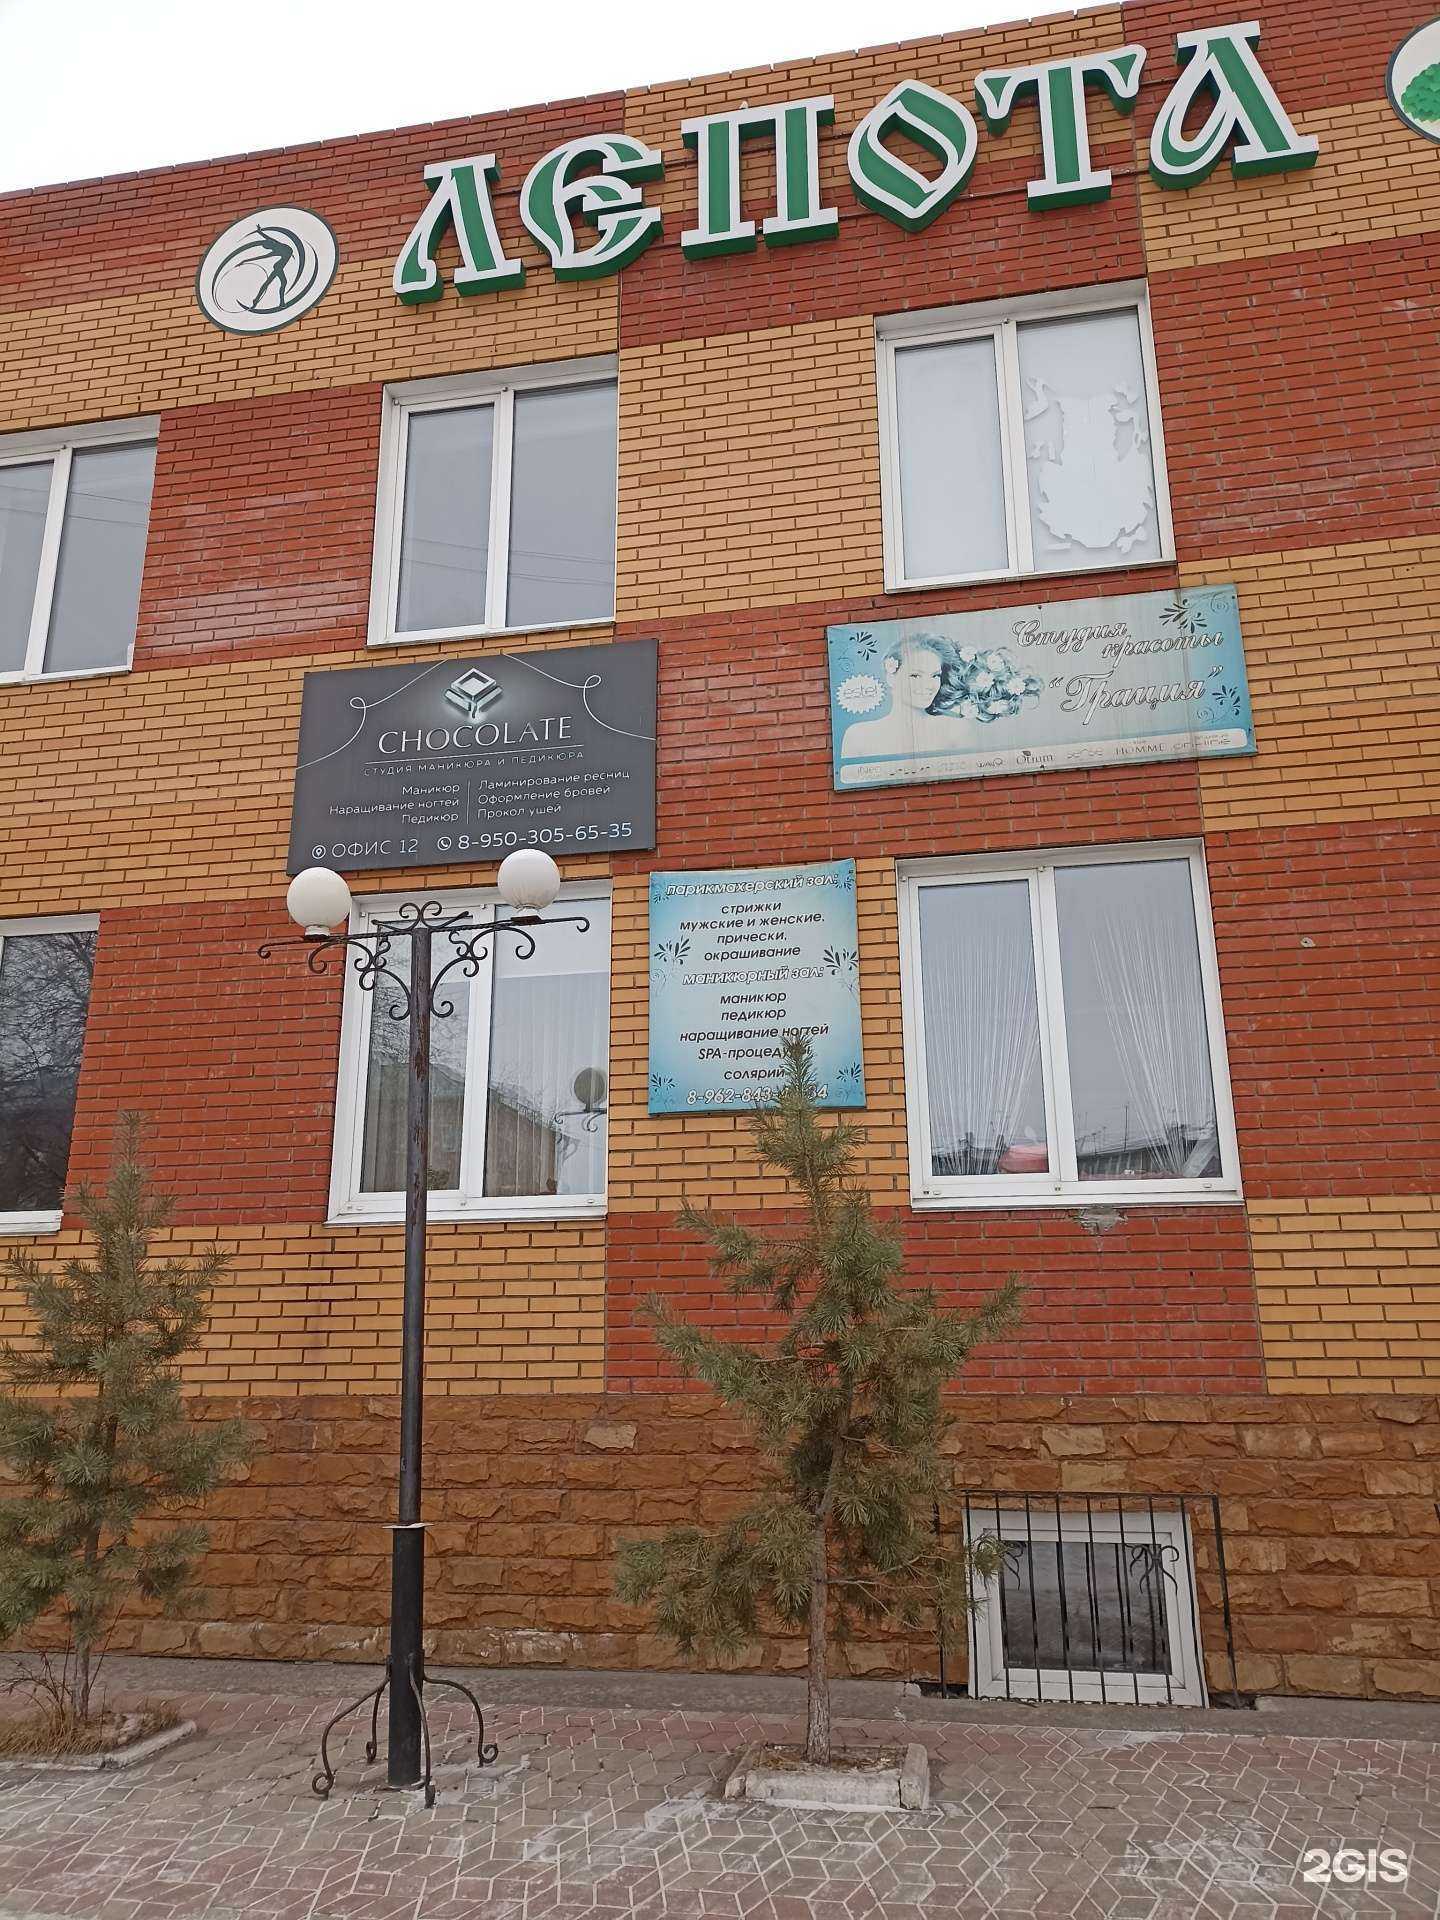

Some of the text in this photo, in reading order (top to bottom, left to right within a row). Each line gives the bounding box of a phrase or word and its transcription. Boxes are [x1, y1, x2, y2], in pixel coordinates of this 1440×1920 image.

[1012, 619, 1128, 654] Студия
[1101, 631, 1225, 669] красоты
[378, 715, 573, 755] CHOCOLATE
[364, 751, 585, 777] СТУДИЯ МАНИКЮРА И ПЕДИКЮРА
[402, 784, 460, 796] Маникюр
[478, 770, 631, 791] Ламинирование ресниц
[478, 786, 611, 805] Оформление бровей
[329, 798, 460, 817] Наращивание ногтей
[478, 804, 562, 820] Прокол ушей
[402, 812, 460, 825] Педикюр
[458, 822, 633, 851] 8-950-305-65-35
[331, 838, 419, 858] ОФИС 12
[665, 873, 839, 897] парикмахерский зал:
[721, 901, 782, 915] стрижки
[680, 918, 744, 931] мужские
[746, 918, 757, 928] и
[704, 946, 801, 962] окрашивание
[682, 965, 825, 985] маникюрный зал:
[720, 991, 787, 1005] маникюр
[721, 1008, 787, 1022] педикюр
[679, 1023, 829, 1043] наращивание ногтей
[723, 1065, 786, 1081] солярий
